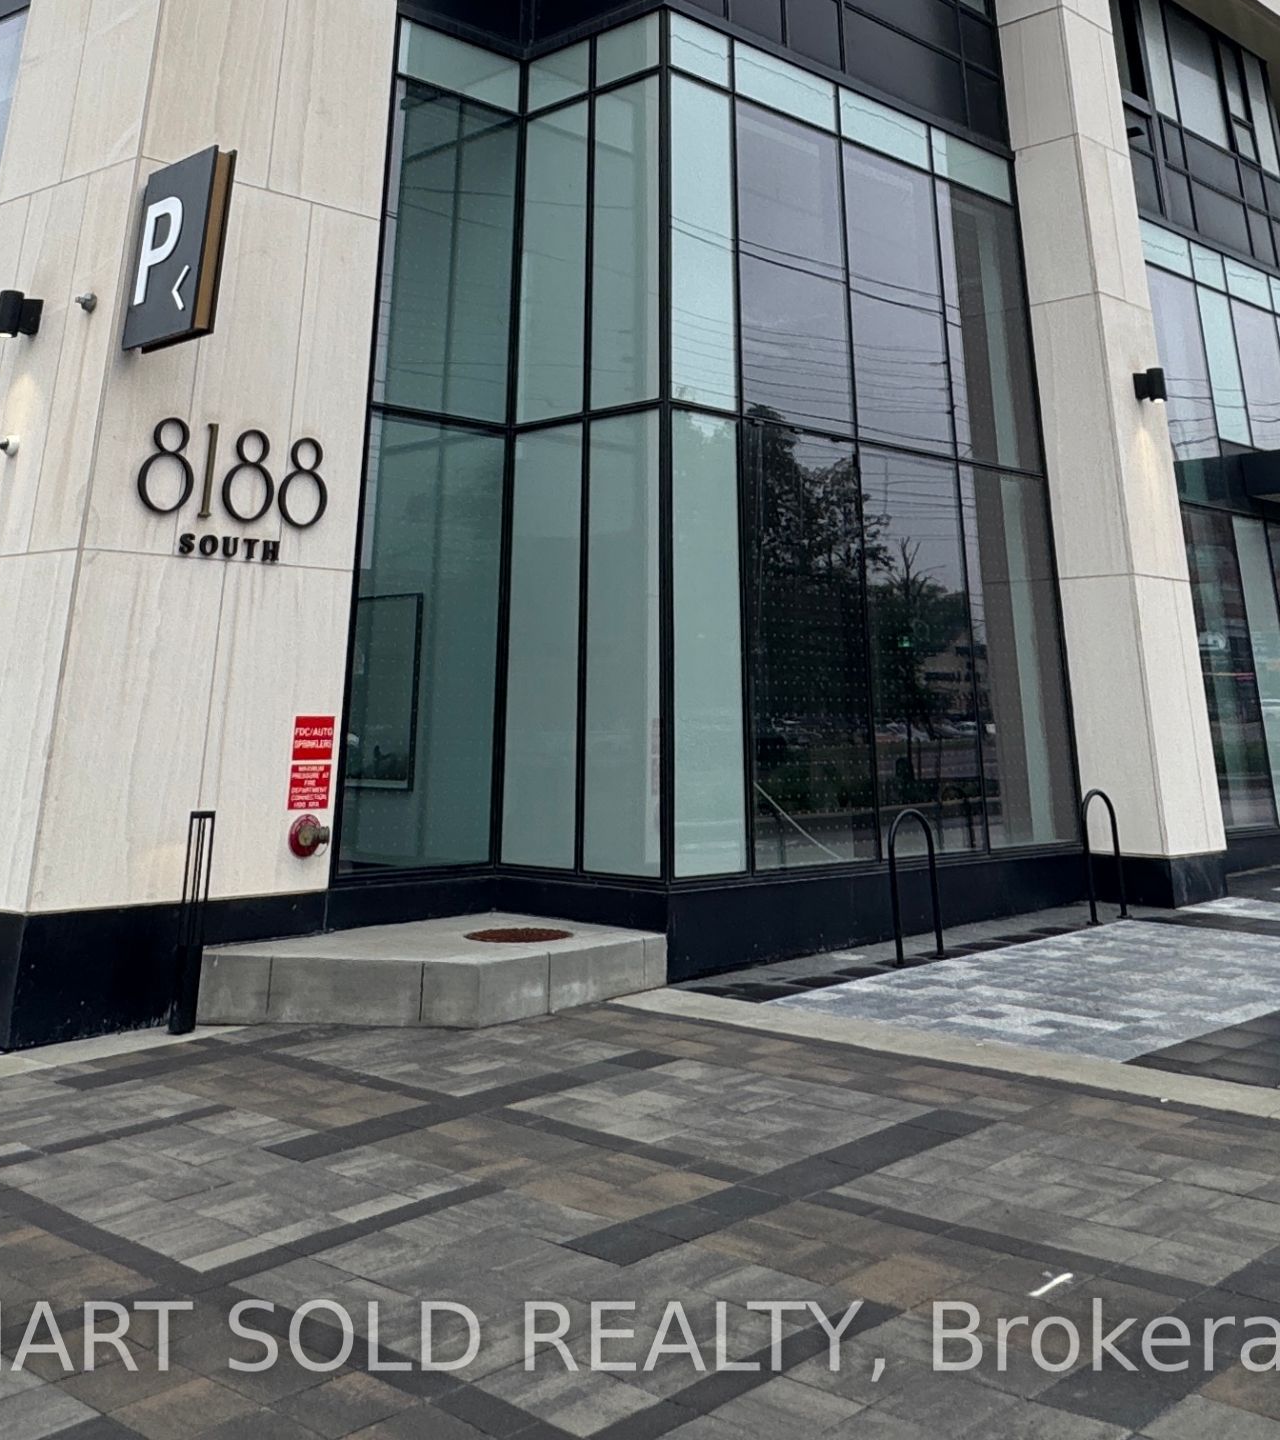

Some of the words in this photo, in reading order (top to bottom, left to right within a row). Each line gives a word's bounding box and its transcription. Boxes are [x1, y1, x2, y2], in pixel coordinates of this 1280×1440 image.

[132, 195, 184, 307] P
[137, 416, 328, 528] 8188
[178, 532, 281, 563] SOUTH
[295, 727, 333, 737] FDC/AUTO
